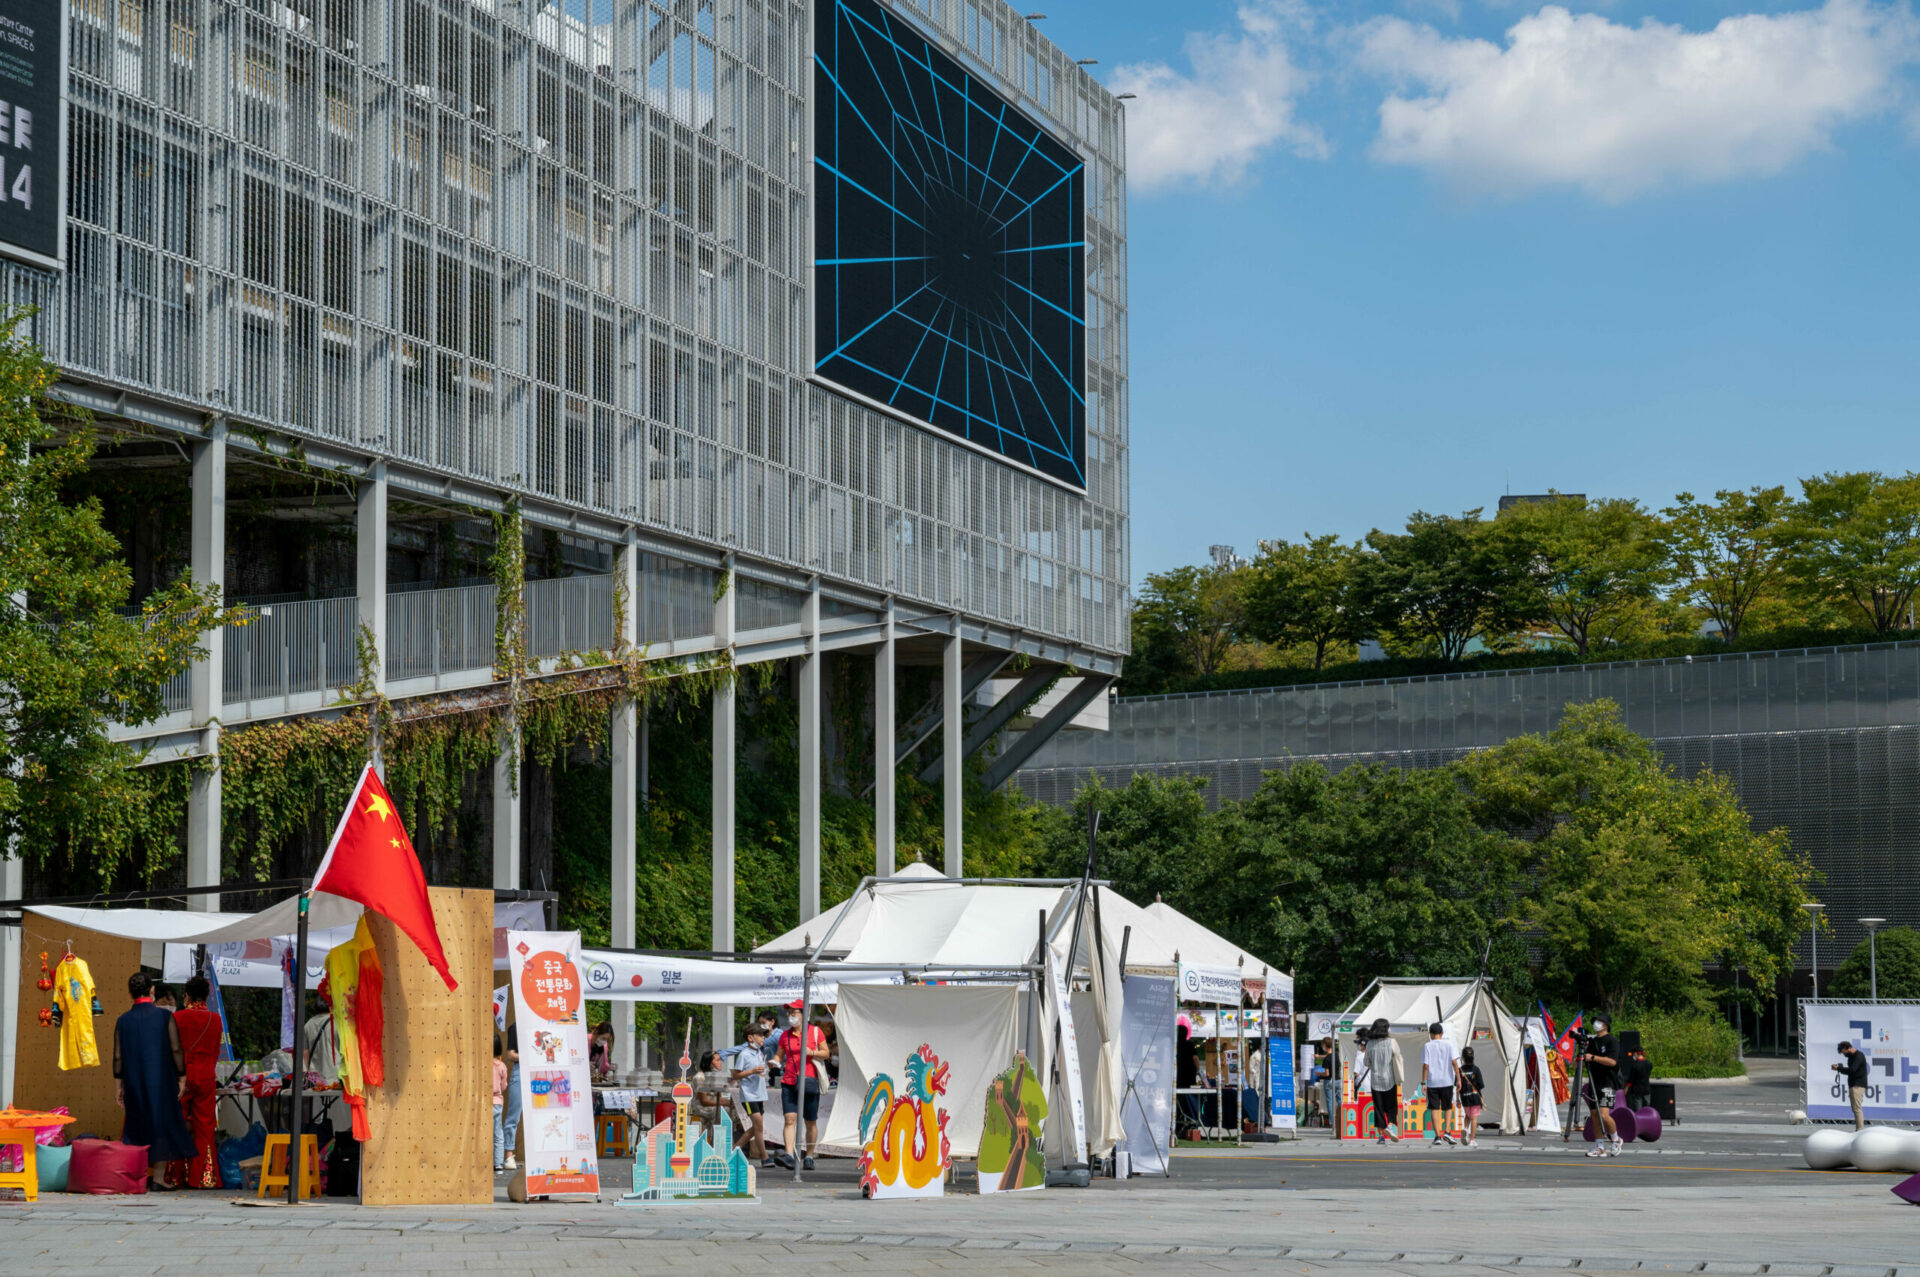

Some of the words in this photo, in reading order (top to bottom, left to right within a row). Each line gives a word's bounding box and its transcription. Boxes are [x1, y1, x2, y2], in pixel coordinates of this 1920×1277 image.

[222, 959, 249, 968] CULTURE
[544, 960, 563, 976] 중국
[221, 967, 241, 975] PLAZA
[594, 970, 609, 982] B4
[661, 970, 682, 985] 일본
[535, 978, 573, 993] 전통문화
[1188, 976, 1197, 986] E2
[547, 996, 567, 1011] 체험
[1321, 1022, 1330, 1031] A5
[1831, 1084, 1882, 1103] 아아
